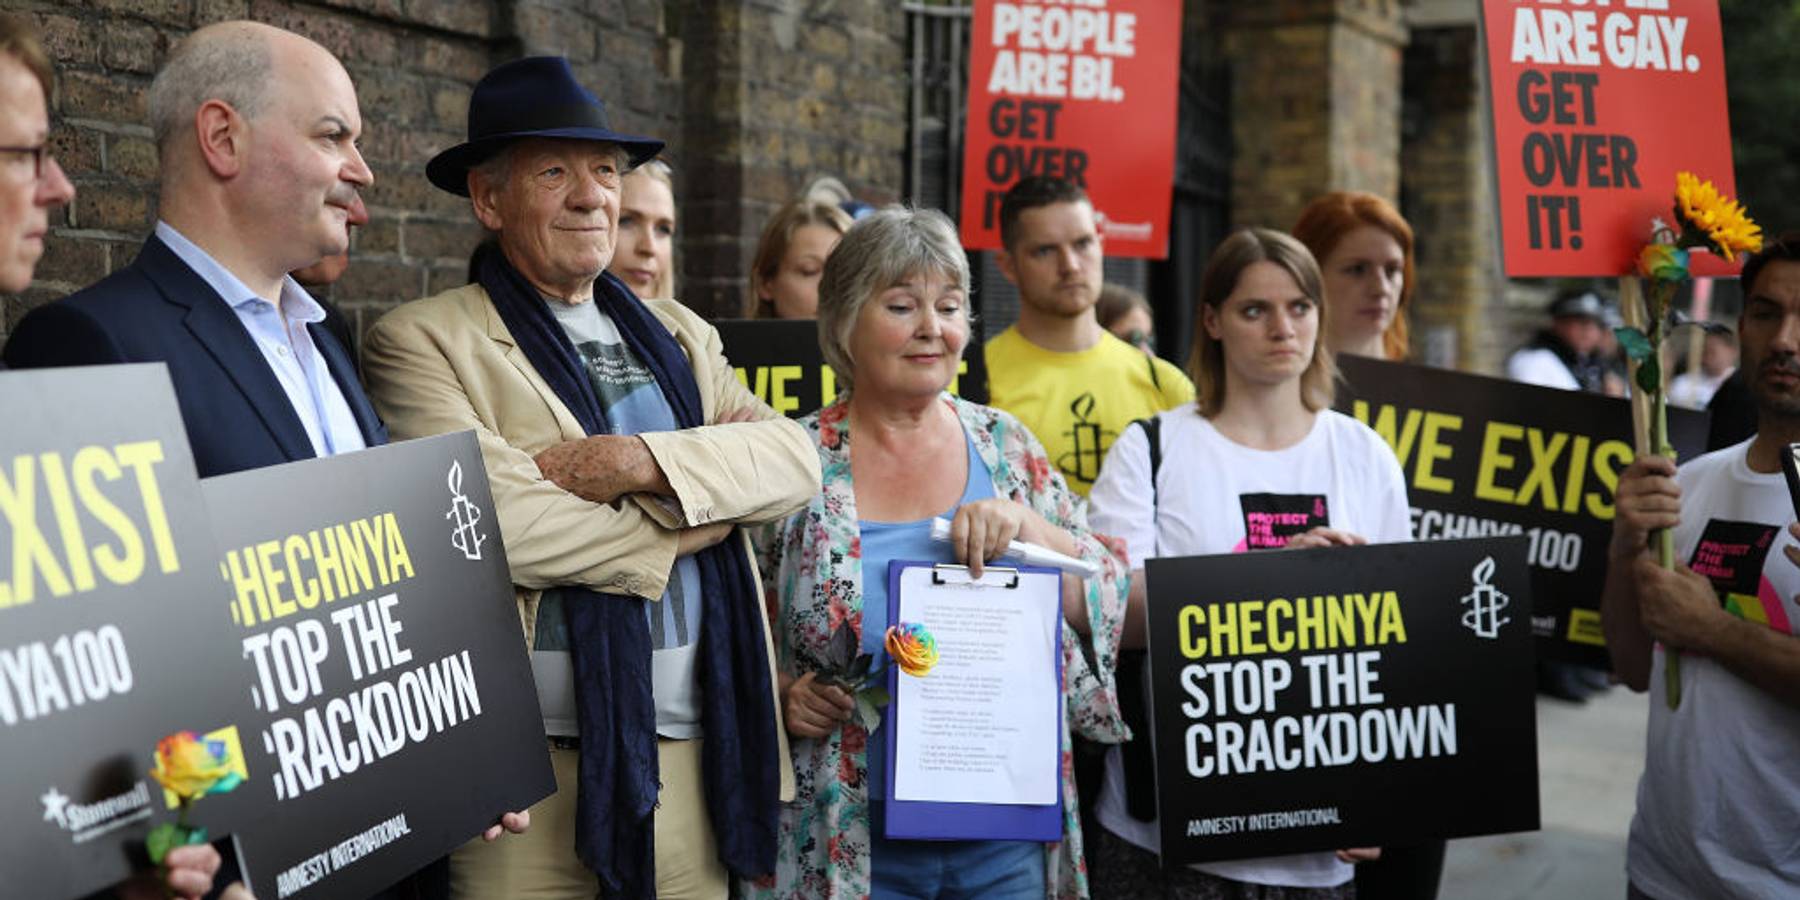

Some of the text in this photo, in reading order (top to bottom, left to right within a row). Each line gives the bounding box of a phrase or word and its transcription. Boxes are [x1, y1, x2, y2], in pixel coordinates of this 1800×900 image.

[992, 3, 1136, 57] PEOPLE
[1511, 7, 1700, 73] ARE GAY.
[988, 50, 1125, 102] ARE BI.
[1517, 69, 1599, 125] GET
[989, 98, 1062, 140] GET
[986, 144, 1088, 188] OVER
[1522, 132, 1642, 188] OVER
[1526, 195, 1583, 250] IT!
[0, 439, 180, 609] XIST
[1248, 513, 1308, 524] PROTECT
[1250, 525, 1272, 536] THE
[242, 592, 413, 712] TOP THE
[1178, 591, 1407, 659] CHECHNYA
[1180, 651, 1384, 718] STOP THE
[1185, 703, 1458, 778] CRACKDOWN
[1187, 807, 1342, 837] AMNESTY INTERNATIONAL
[276, 812, 411, 899] AMNESTY INTERNATIONAL
